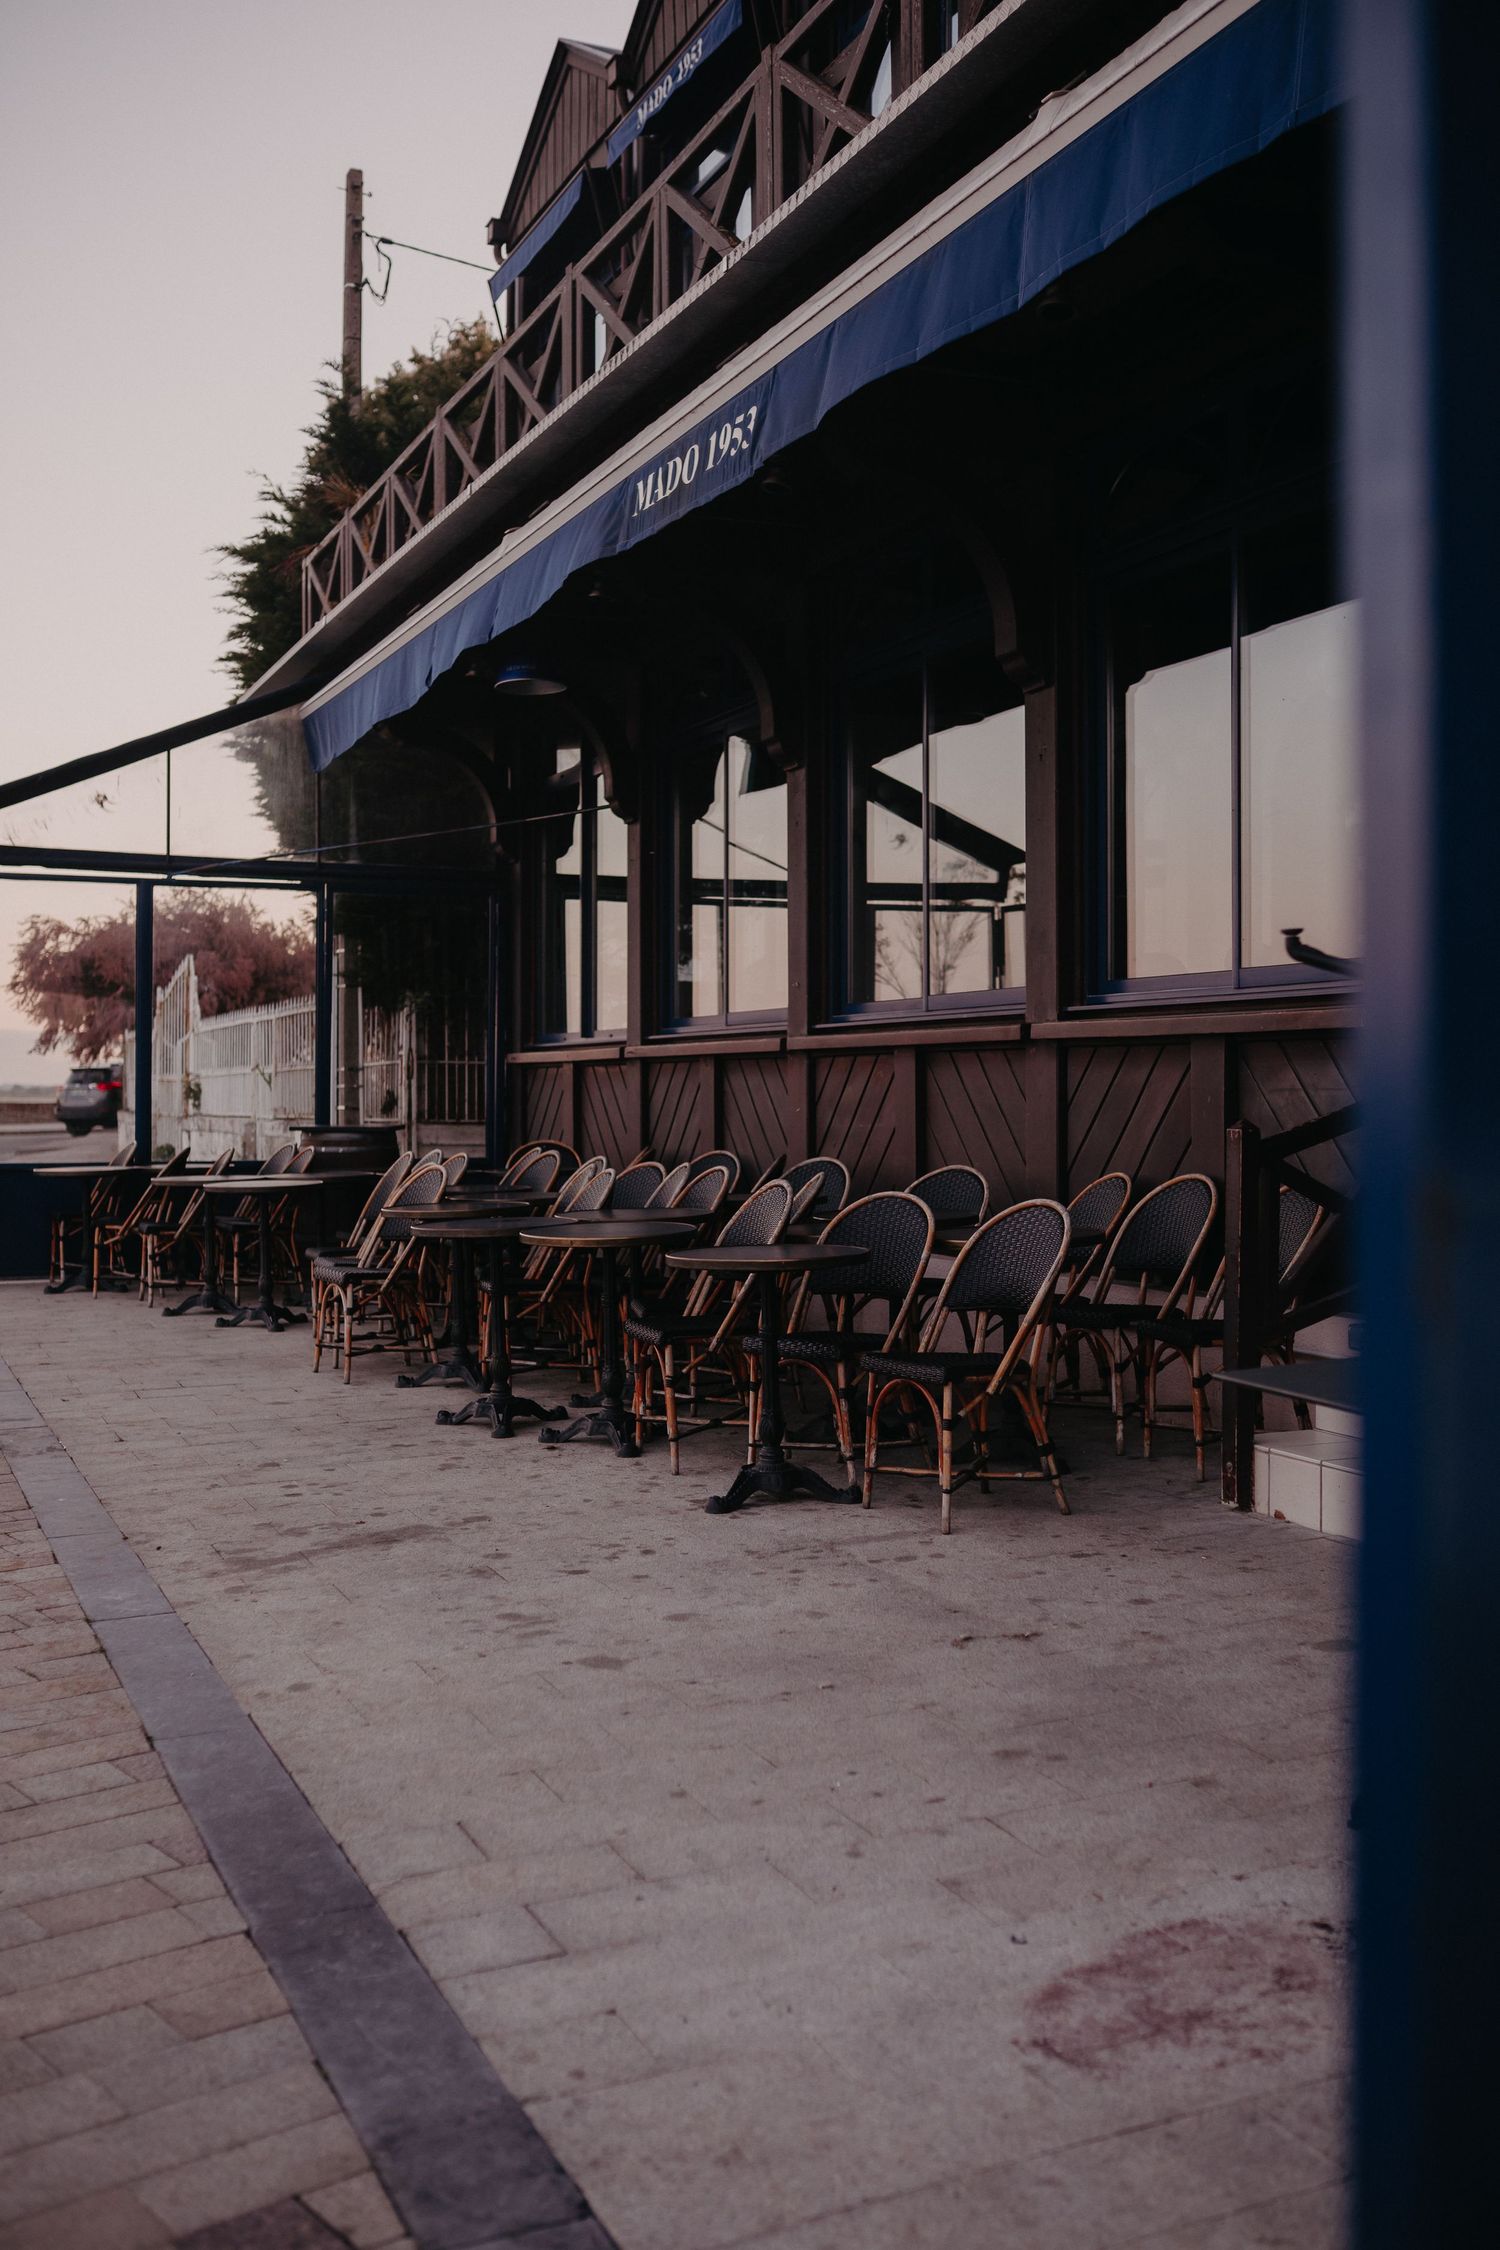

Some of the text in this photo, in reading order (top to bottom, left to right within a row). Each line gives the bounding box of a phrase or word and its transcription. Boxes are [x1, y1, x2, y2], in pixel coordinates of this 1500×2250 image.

[677, 38, 703, 82] 1953
[632, 405, 758, 517] MADO 1953
